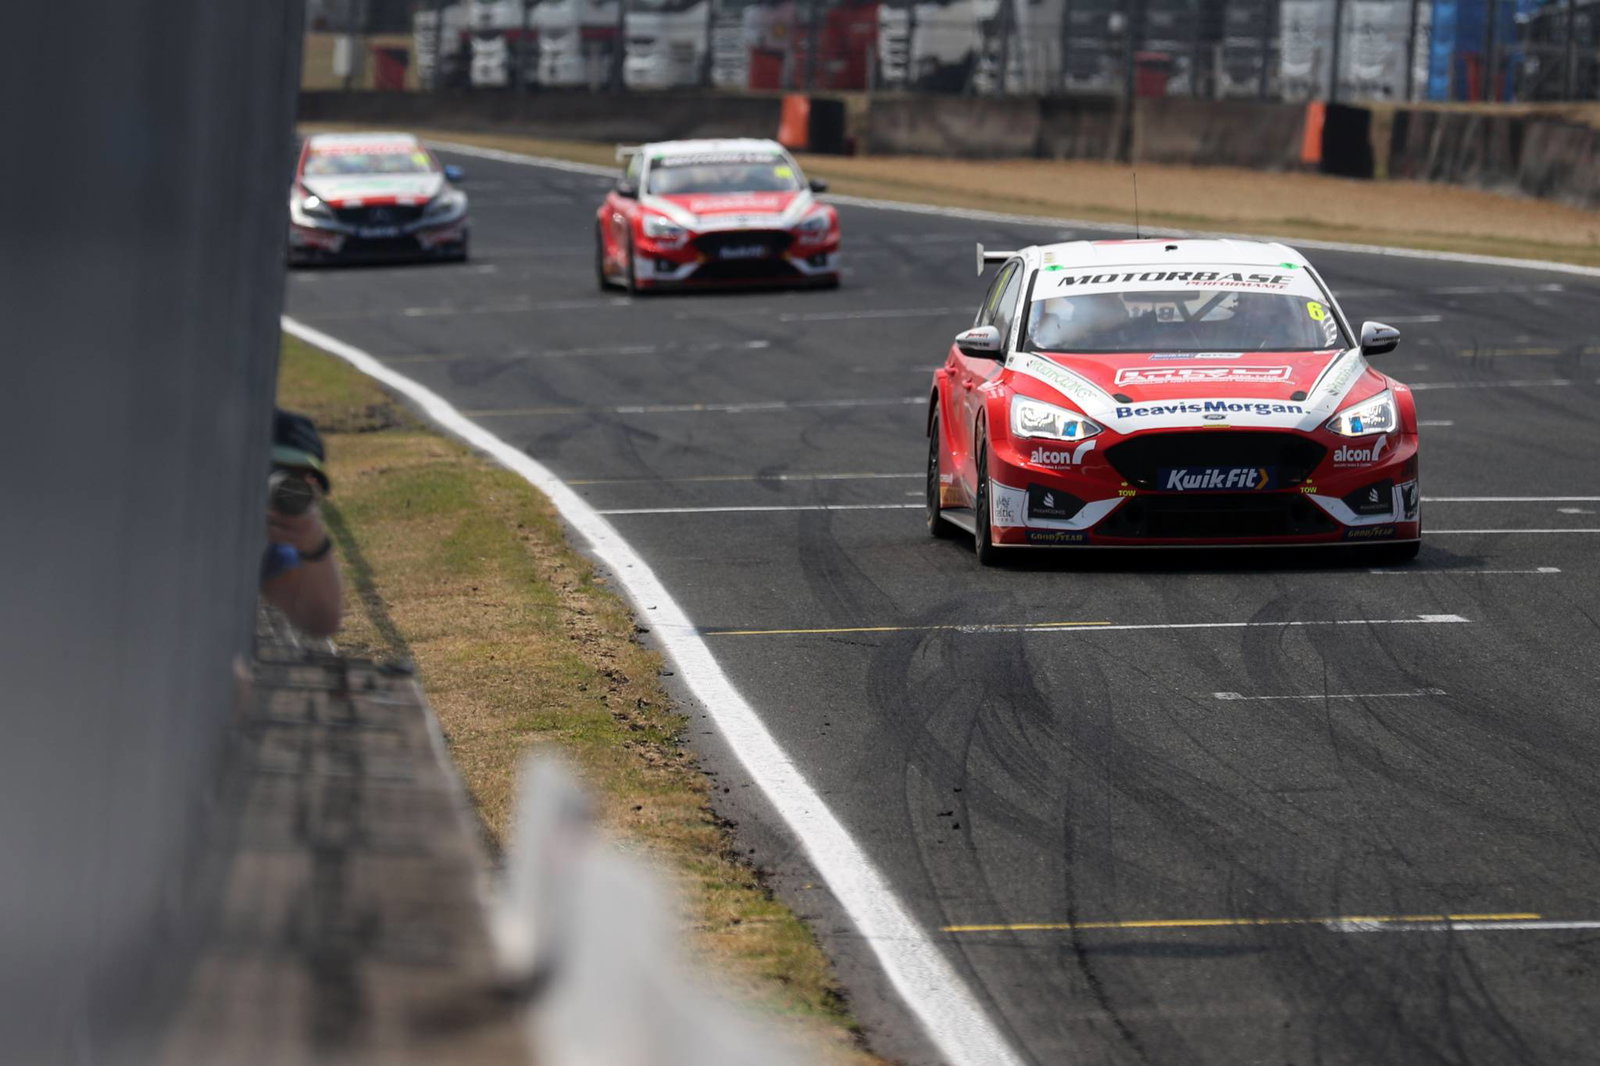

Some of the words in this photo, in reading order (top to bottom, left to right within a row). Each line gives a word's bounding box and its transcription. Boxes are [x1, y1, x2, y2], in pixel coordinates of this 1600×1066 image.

[1057, 271, 1294, 287] MOTORBASE
[1185, 281, 1287, 289] PERFORMANCE
[1307, 302, 1325, 320] 6
[1031, 447, 1071, 464] alcon
[1333, 445, 1371, 461] alcon
